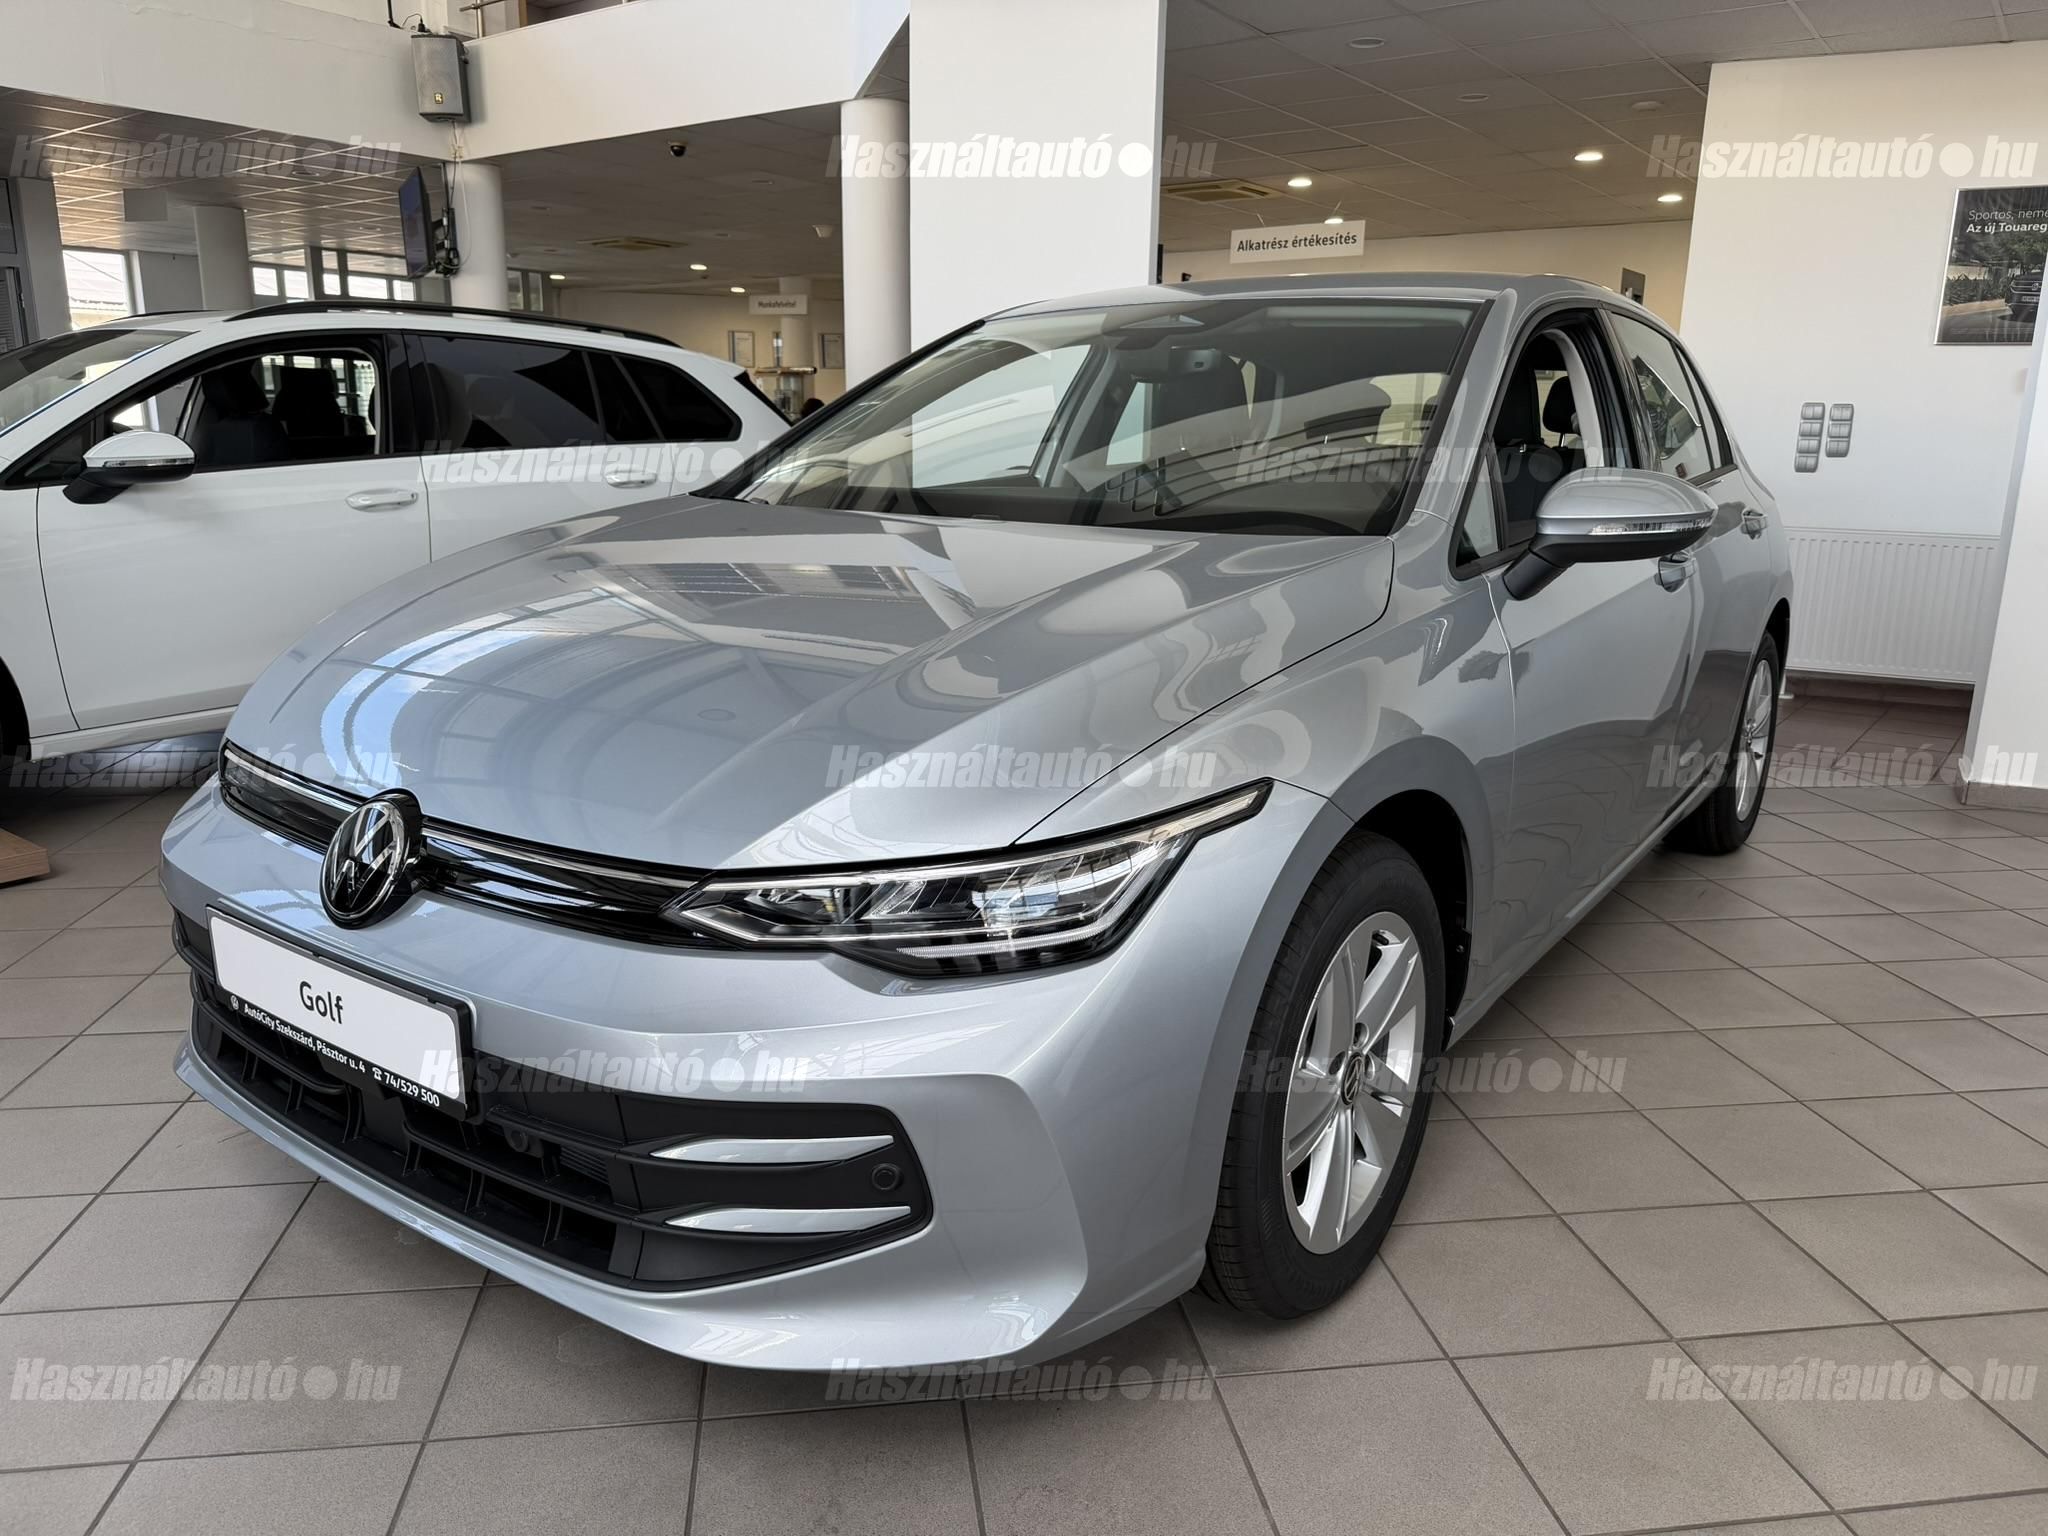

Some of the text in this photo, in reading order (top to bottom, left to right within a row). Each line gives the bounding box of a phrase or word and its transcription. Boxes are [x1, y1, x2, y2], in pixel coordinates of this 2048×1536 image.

[1968, 209, 2014, 221] Sportos,
[1966, 222, 2048, 235] Az új Touareg
[1237, 232, 1357, 252] Alkatrész értékesítés
[299, 980, 344, 1025] Golf
[244, 1003, 440, 1107] AutóCity Szekszárd, Pásztor u. 4 74/529 500
